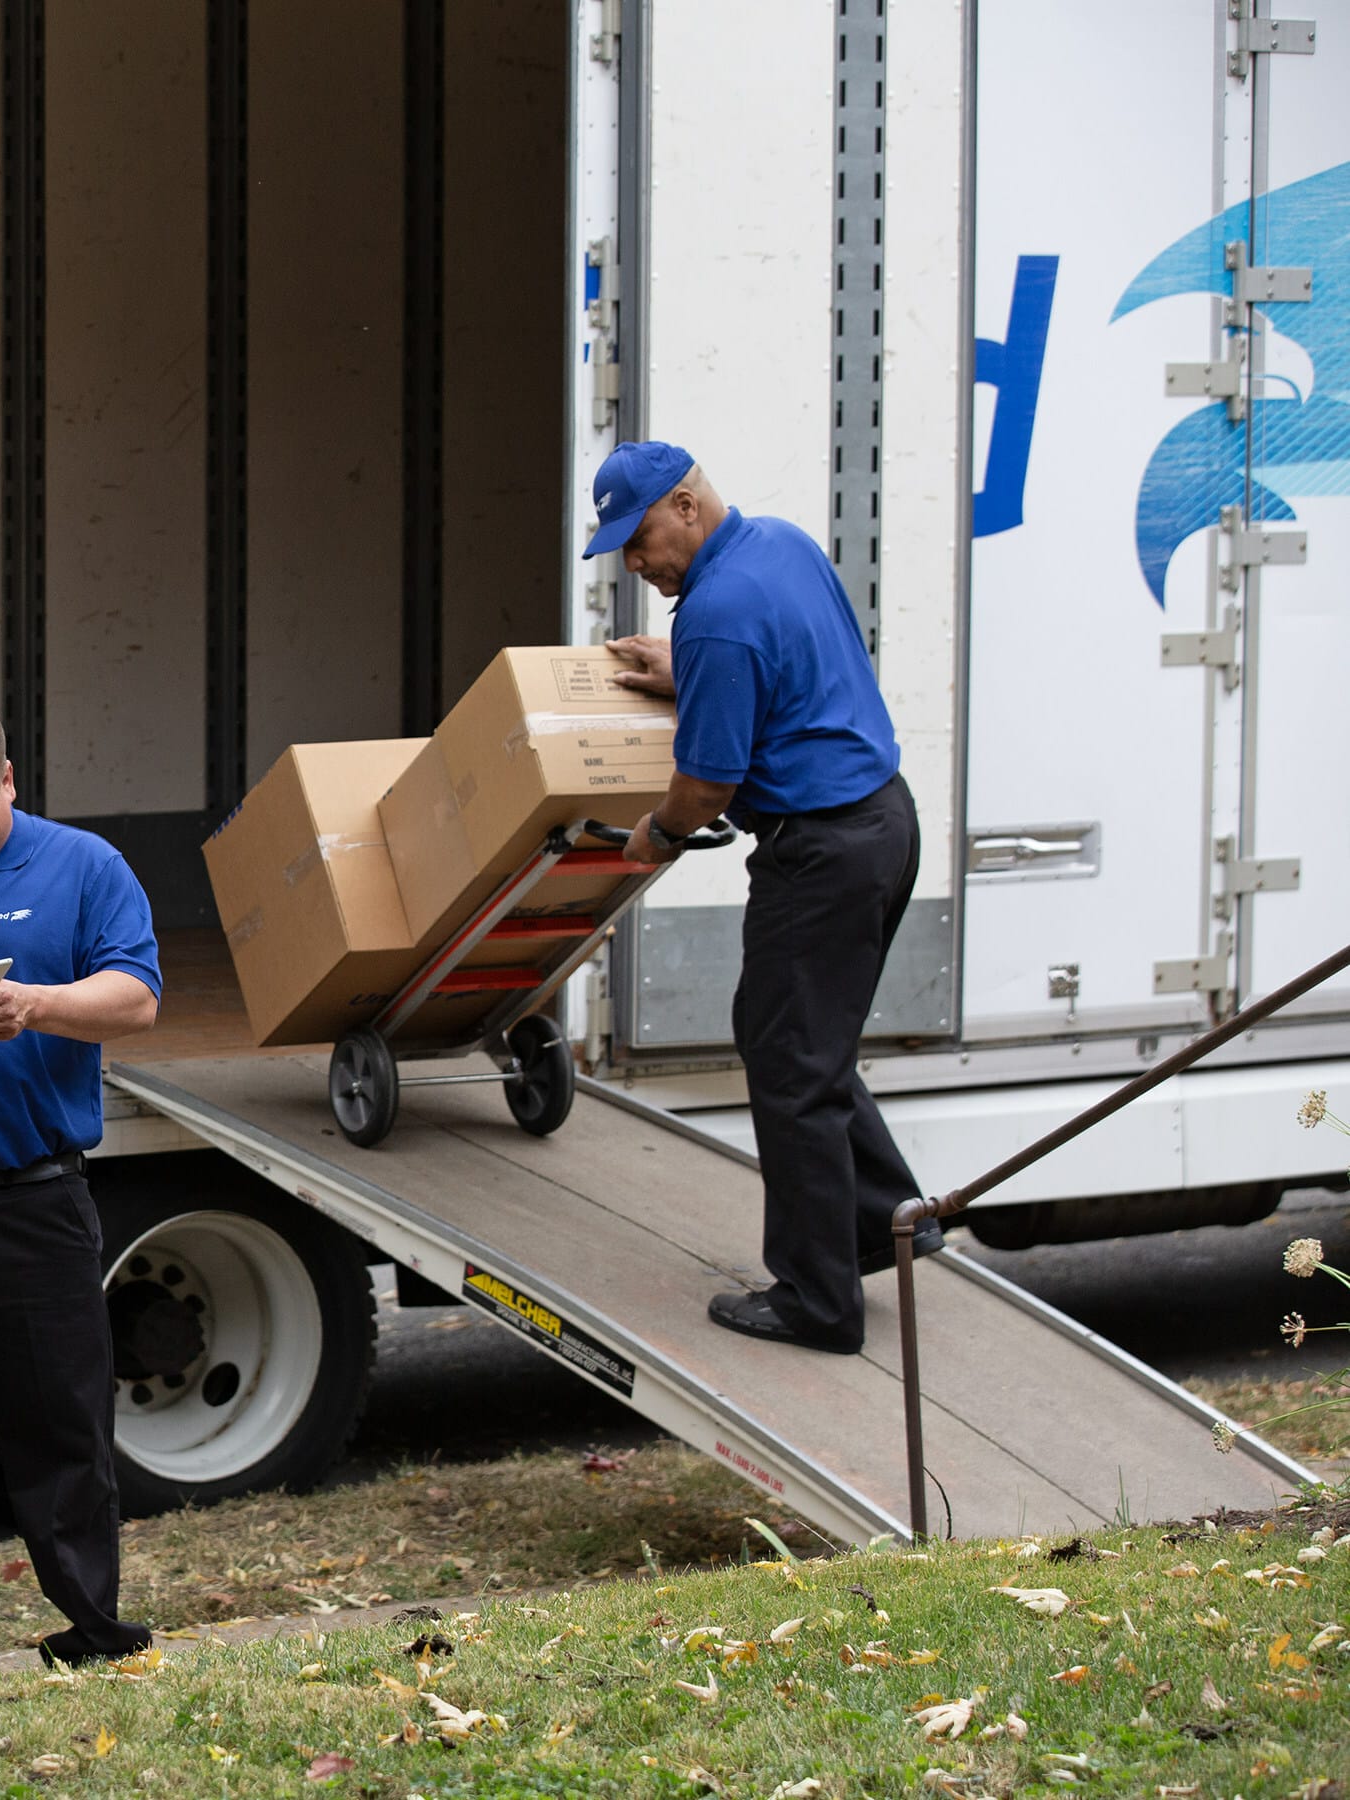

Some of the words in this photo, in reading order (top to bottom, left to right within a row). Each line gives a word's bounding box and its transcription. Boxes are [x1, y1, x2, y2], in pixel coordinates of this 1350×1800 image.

[624, 737, 642, 746] DATE
[583, 757, 604, 767] NAME
[588, 775, 627, 785] CONTENTS
[481, 1273, 562, 1338] MELCHER
